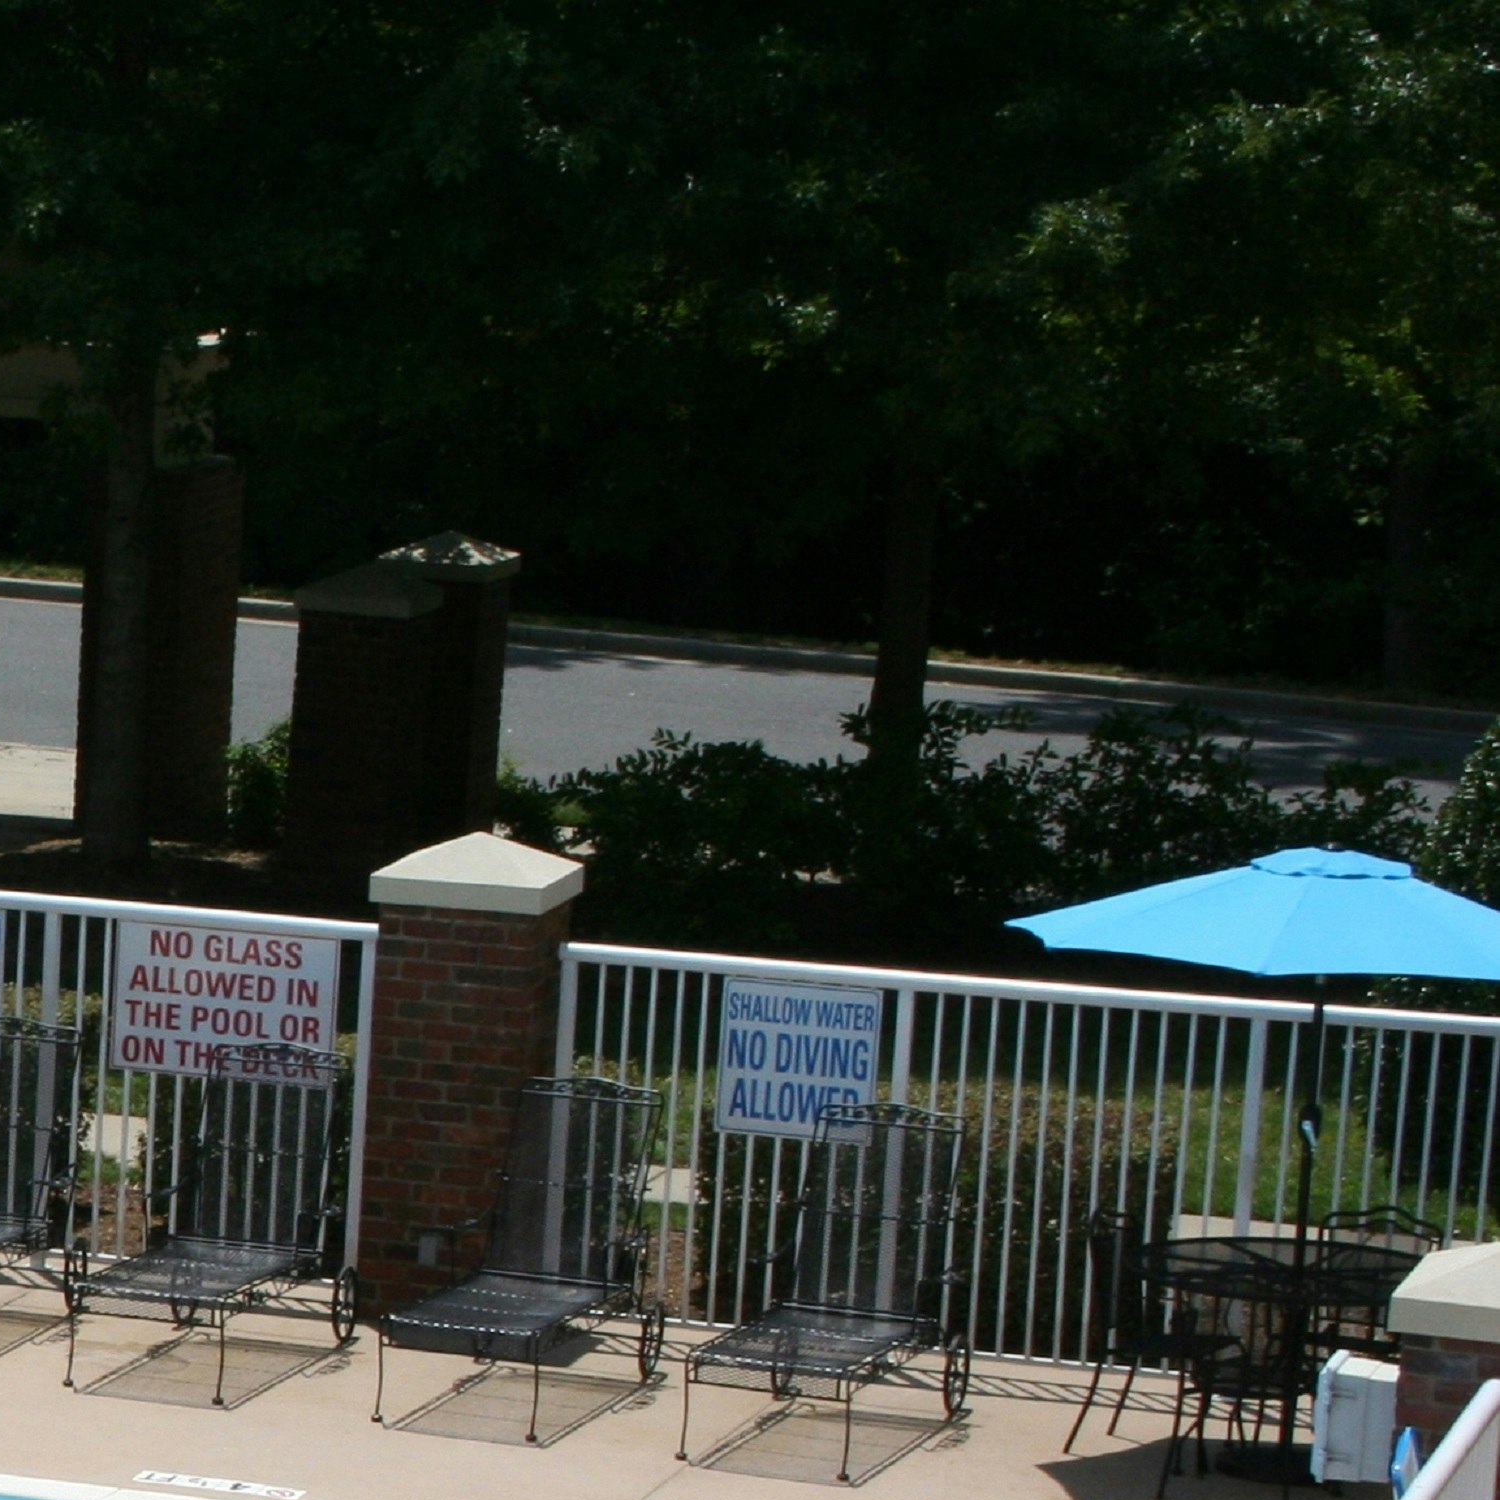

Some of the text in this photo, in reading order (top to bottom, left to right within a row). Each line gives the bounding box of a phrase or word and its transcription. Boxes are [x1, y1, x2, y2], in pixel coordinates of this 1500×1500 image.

[150, 930, 303, 969] NO GLASS
[129, 965, 319, 1008] ALLOWED IN
[125, 1000, 320, 1044] THE POOL OR
[728, 992, 875, 1032] SHALLOW WATER
[121, 1035, 320, 1080] ON THE DECK
[727, 1029, 869, 1081] NO DIVING
[728, 1078, 859, 1128] ALLOWED
